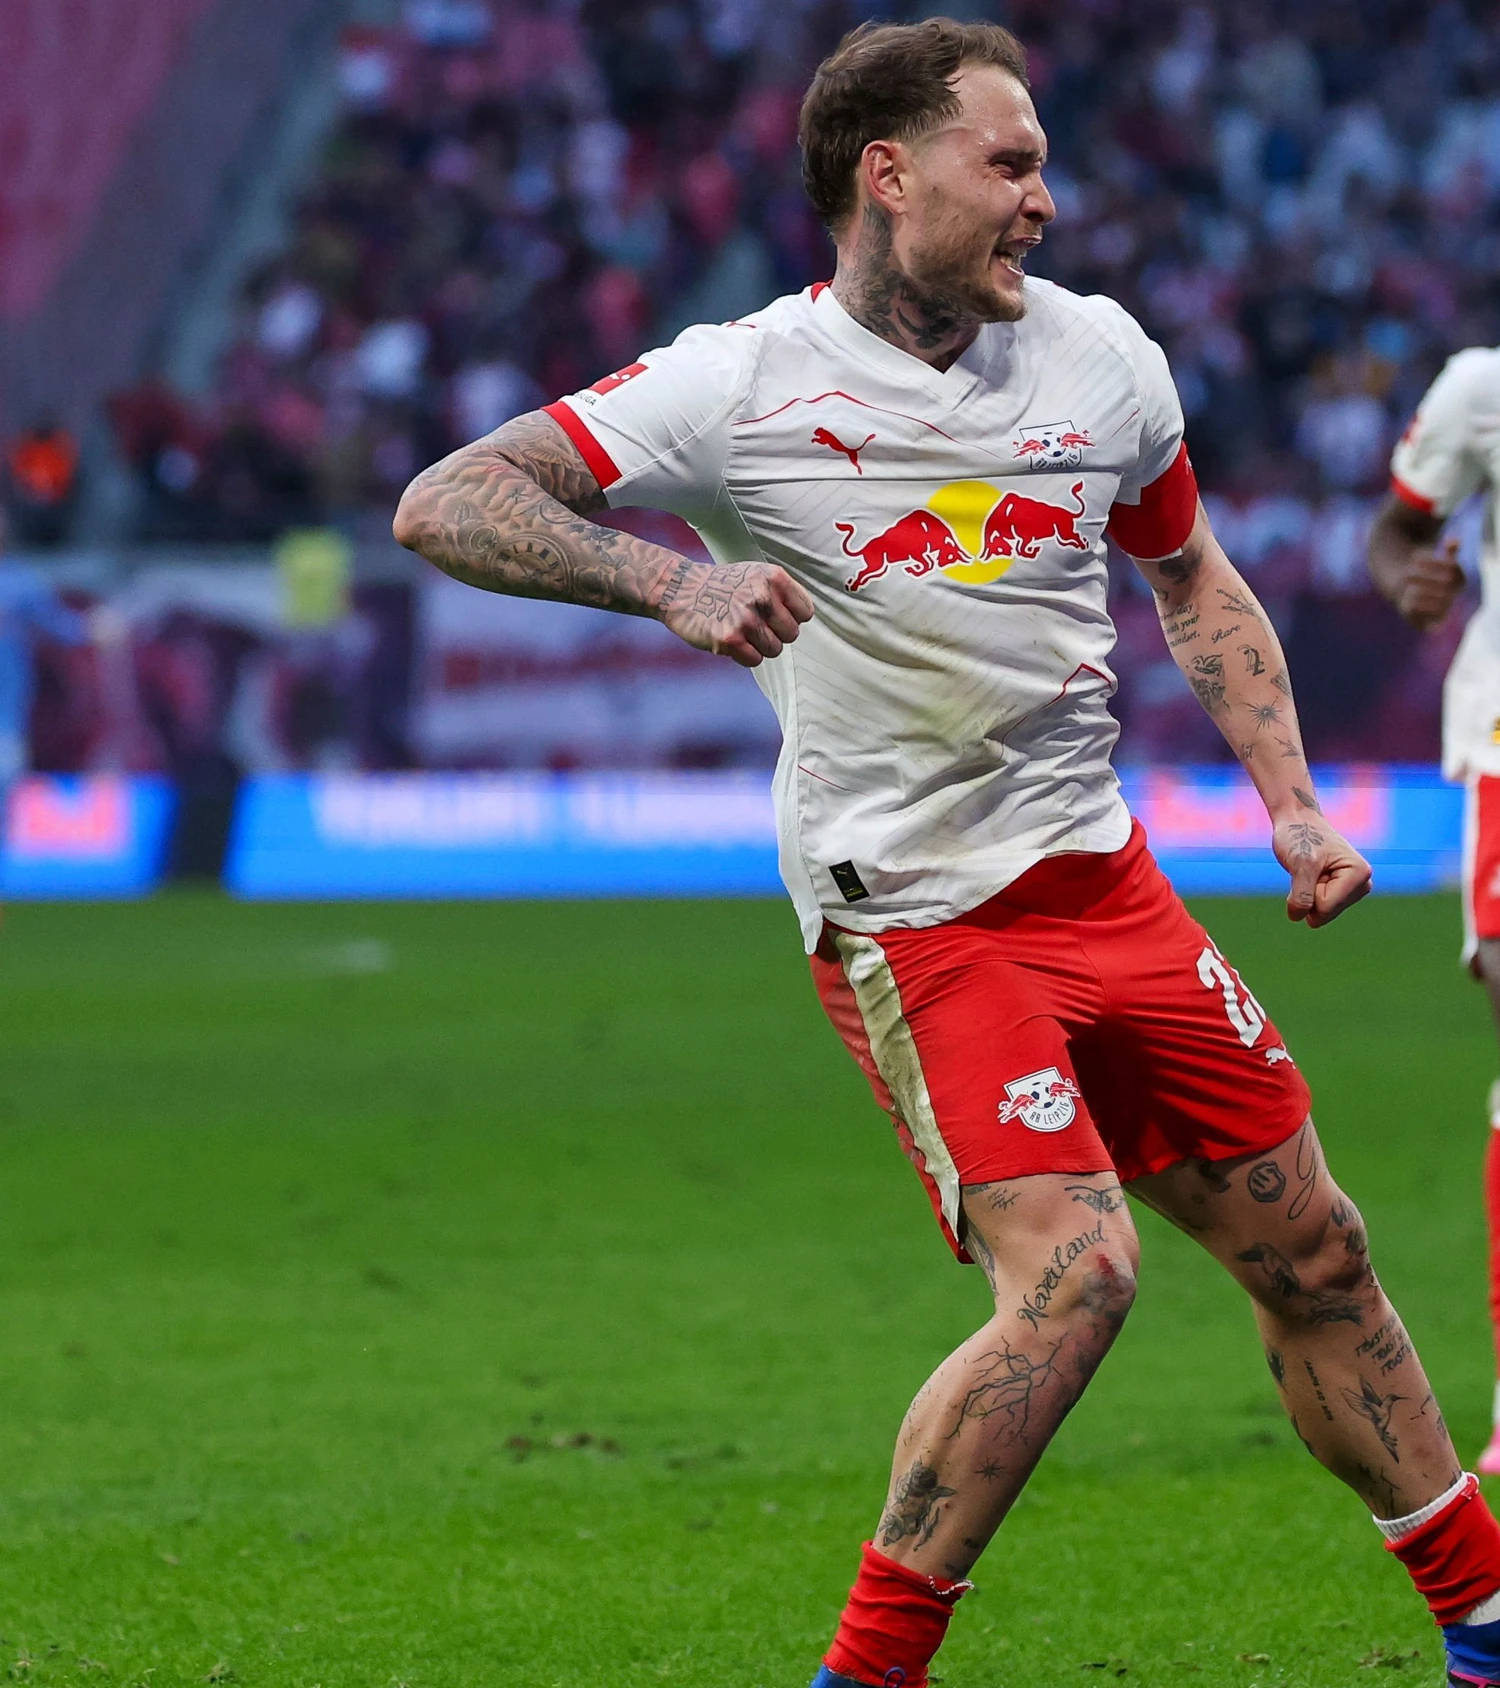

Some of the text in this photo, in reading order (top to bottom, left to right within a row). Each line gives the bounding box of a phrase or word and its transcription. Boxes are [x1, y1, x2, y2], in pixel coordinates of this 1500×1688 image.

[1029, 1101, 1070, 1125] RB LEIPZIG
[1016, 1219, 1109, 1333] Neverland
